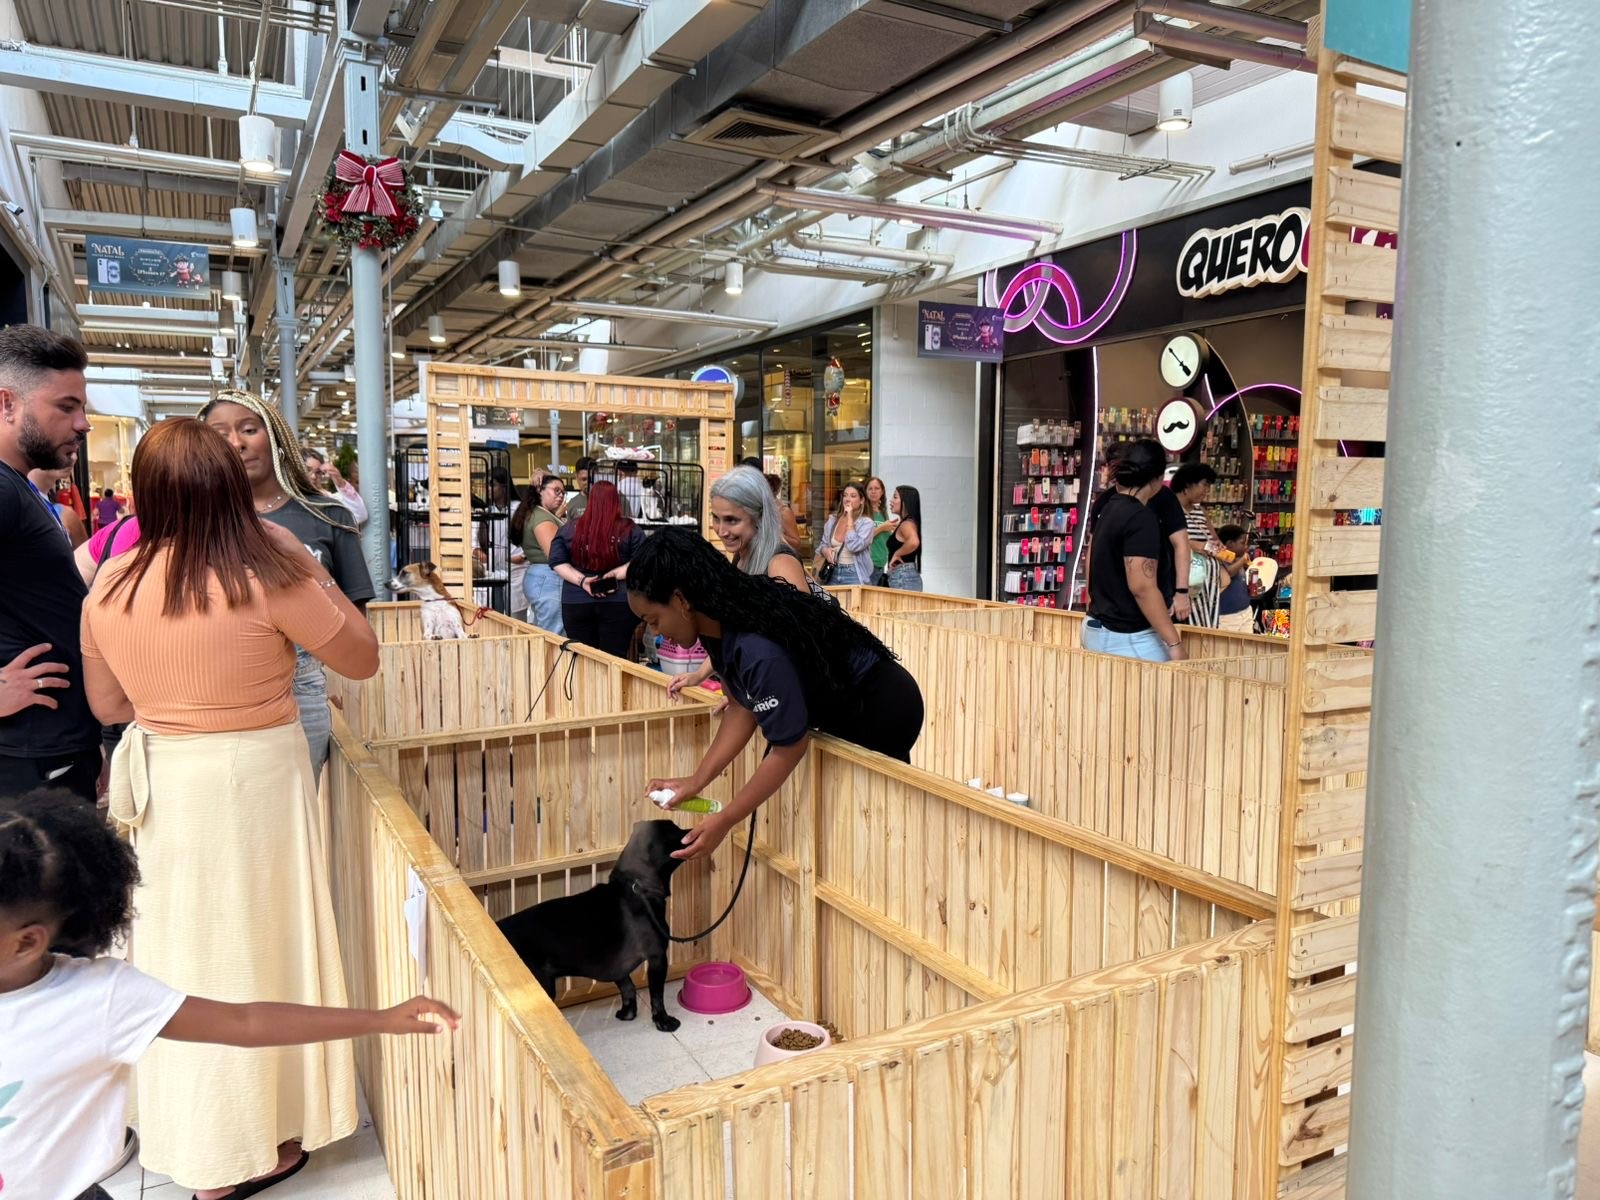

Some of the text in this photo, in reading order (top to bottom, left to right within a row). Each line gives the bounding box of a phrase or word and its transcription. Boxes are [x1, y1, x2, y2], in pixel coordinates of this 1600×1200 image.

[91, 243, 125, 256] NATAL
[1180, 213, 1302, 292] QUERO
[922, 308, 945, 321] NATAL
